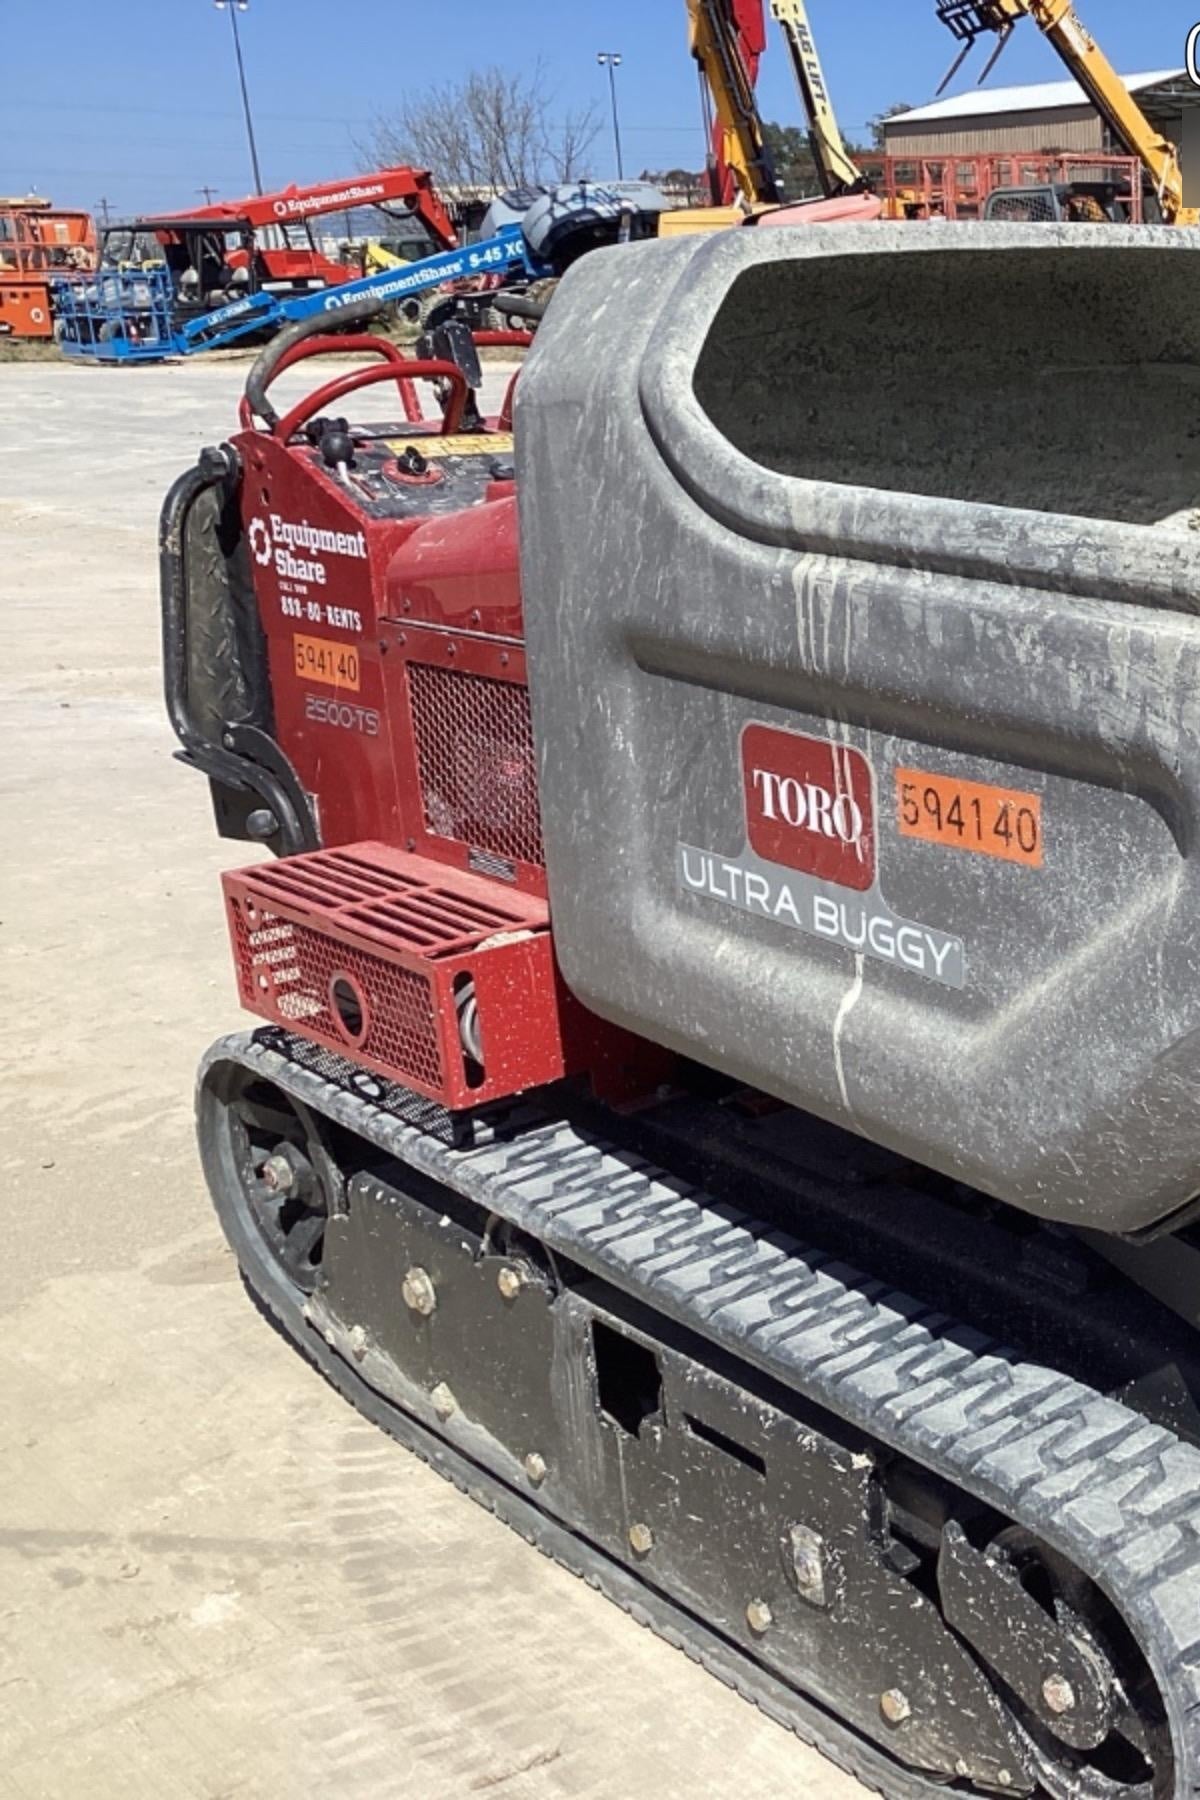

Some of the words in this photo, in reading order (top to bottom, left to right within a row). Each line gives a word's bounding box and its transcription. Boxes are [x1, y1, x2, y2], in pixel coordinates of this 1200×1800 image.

[794, 19, 813, 54] JLG
[806, 61, 827, 103] LIFT
[287, 184, 385, 213] EquipmentShare
[469, 245, 502, 268] S-45
[505, 240, 524, 256] XC
[269, 514, 368, 559] Equipment
[275, 549, 327, 584] Share
[296, 643, 358, 683] 594140
[752, 769, 864, 844] TORO
[901, 784, 1037, 854] 594140
[681, 851, 801, 926] ULTRA
[813, 897, 951, 976] BUGGY
